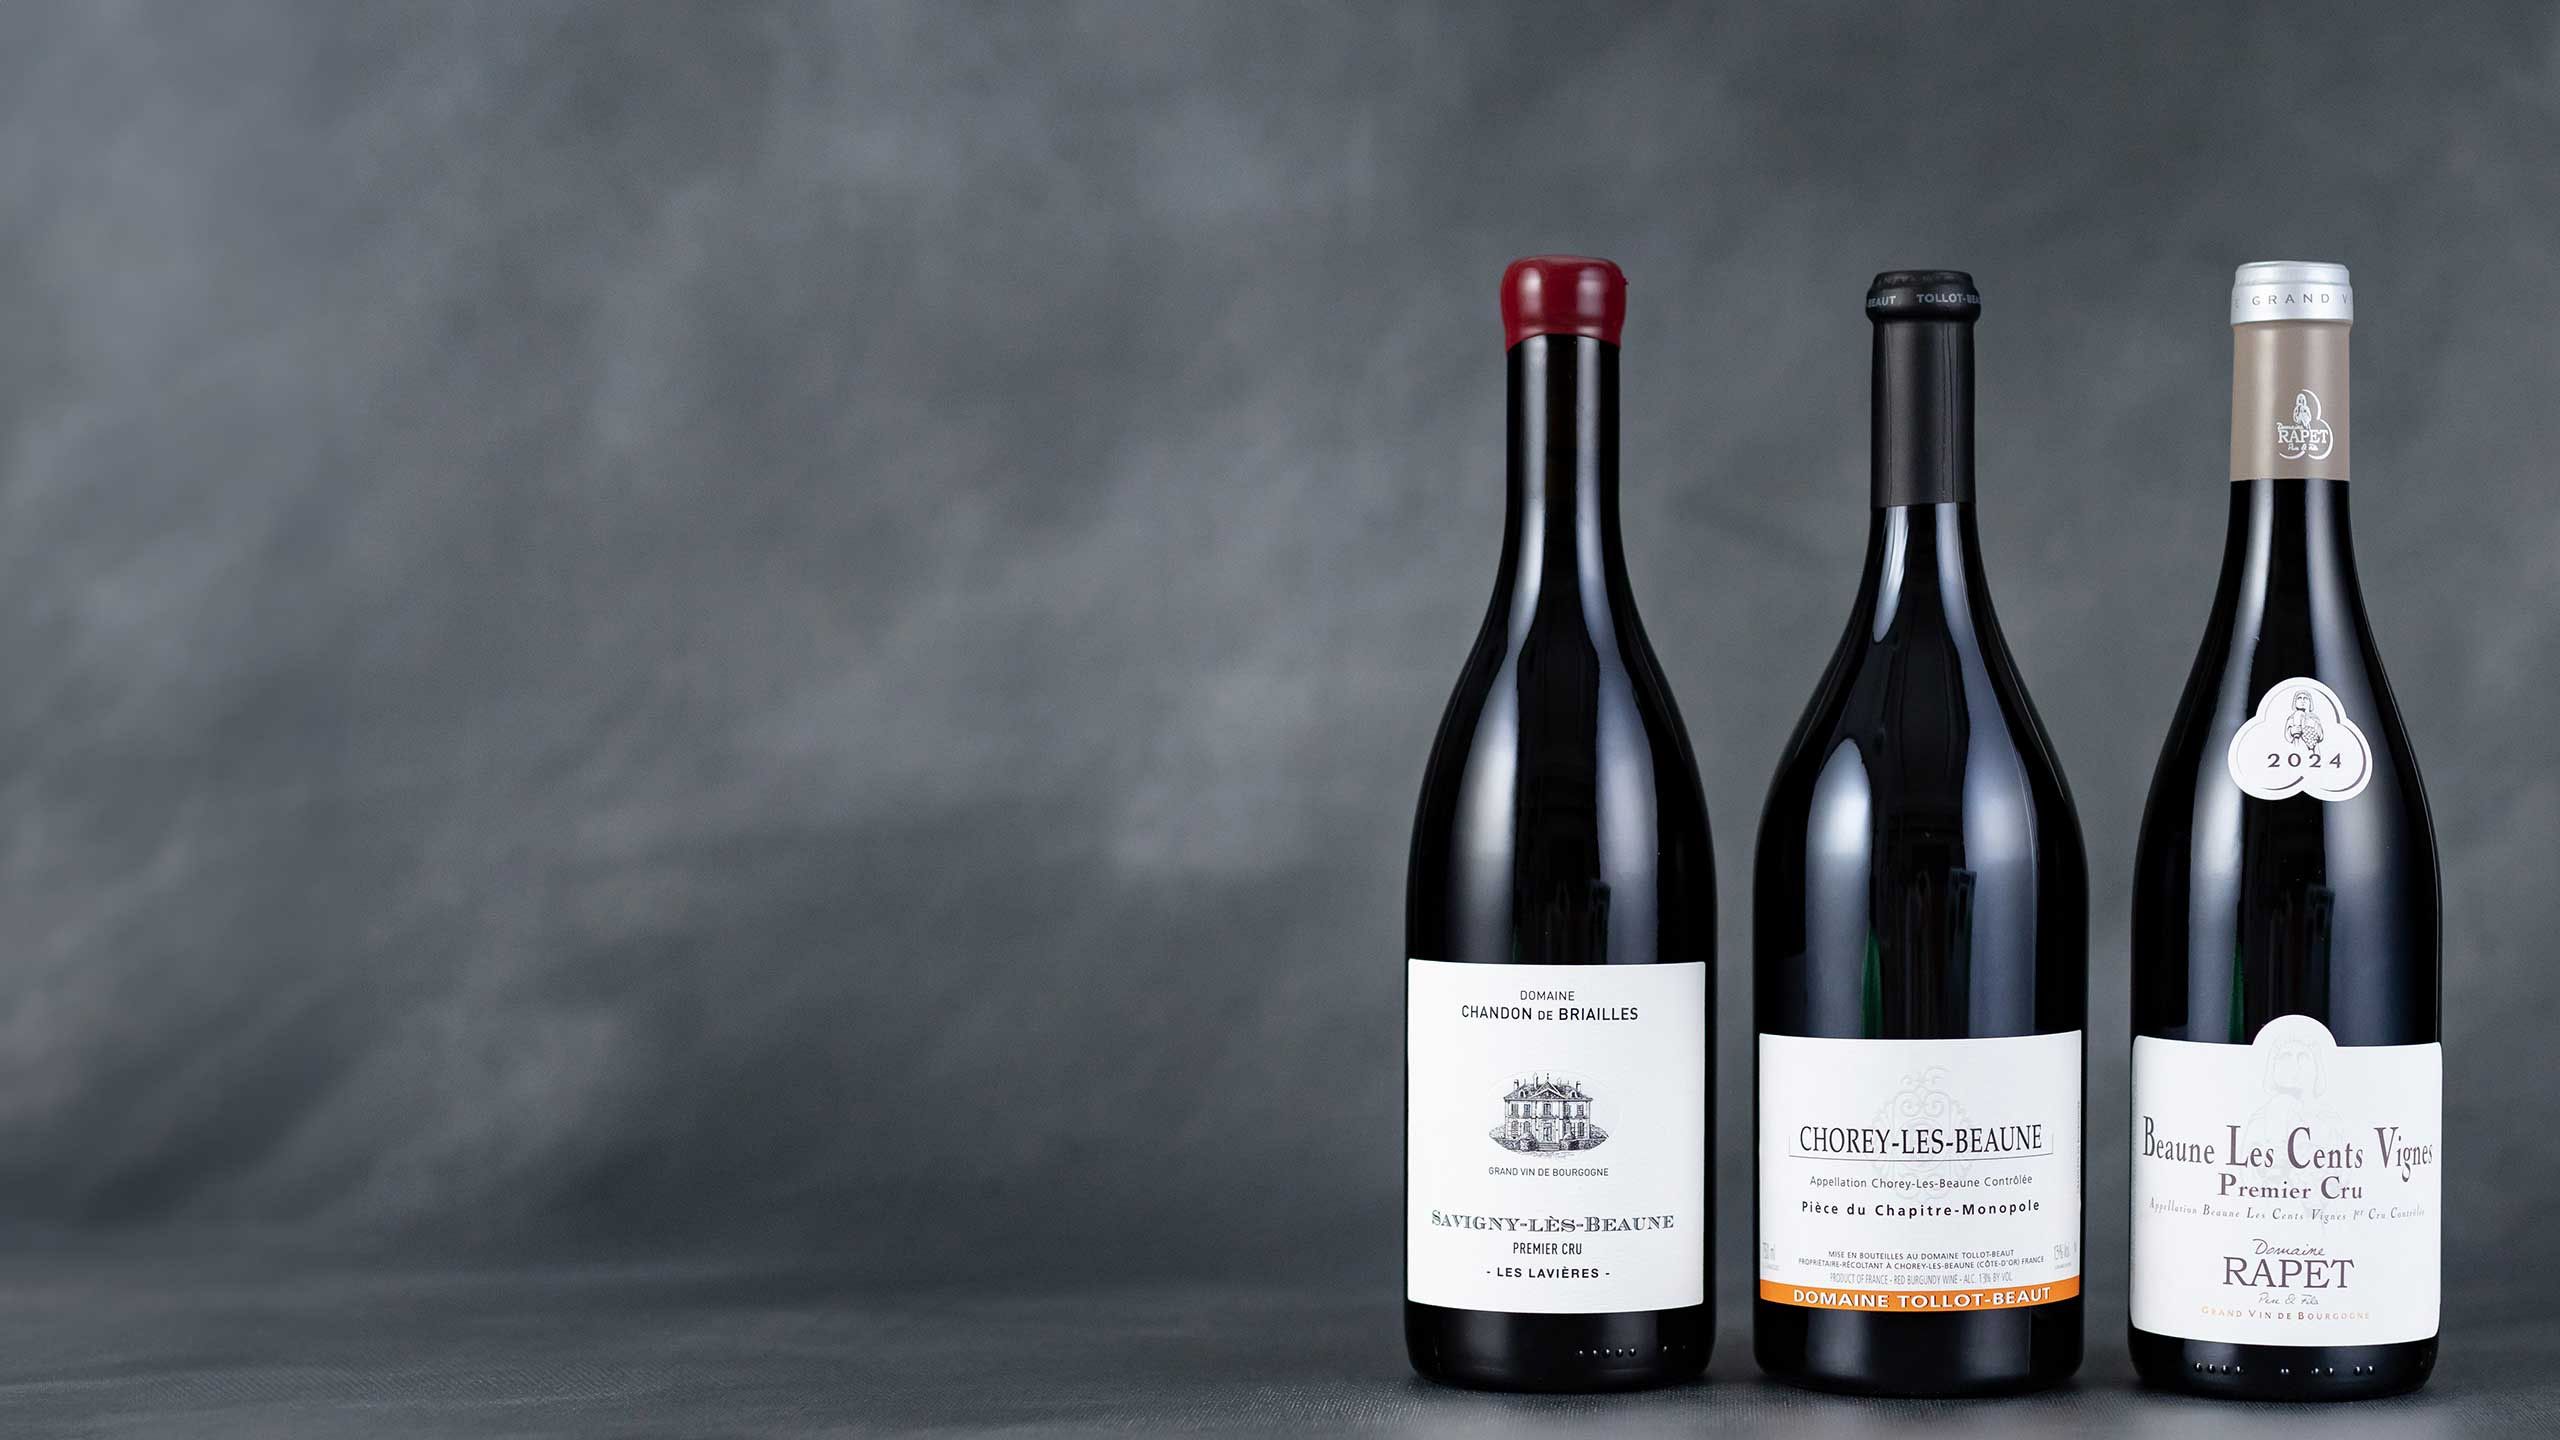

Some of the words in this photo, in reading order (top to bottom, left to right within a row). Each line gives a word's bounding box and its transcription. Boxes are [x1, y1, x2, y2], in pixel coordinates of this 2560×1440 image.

[2251, 293, 2330, 306] GRAND
[2278, 429, 2329, 444] RAPET
[2267, 753, 2342, 769] 2024
[1519, 990, 1576, 1002] DOMAINE
[1461, 1004, 1532, 1021] CHANDON
[1537, 1009, 1554, 1021] DE
[1558, 1007, 1639, 1022] BRIAILLES
[1799, 1123, 2043, 1155] CHOREY-LES-BEAUNE
[2142, 1115, 2216, 1164] Beaune
[2225, 1124, 2274, 1169] Les
[2287, 1126, 2364, 1170] Cents
[2373, 1126, 2433, 1183] Vignes
[1488, 1166, 1519, 1177] GRAND
[1520, 1167, 1536, 1177] VIN
[1537, 1167, 1550, 1177] DE
[1552, 1167, 1609, 1177] BOURGOGNE
[1809, 1175, 1867, 1191] Appellation
[1871, 1177, 1981, 1191] Chorey-Les-Beaune
[1983, 1173, 2033, 1187] Contrôlée
[2216, 1172, 2312, 1200] Premier
[2320, 1175, 2363, 1200] Cru
[1801, 1200, 1839, 1215] Pièce
[1846, 1201, 1866, 1216] du
[1874, 1199, 2040, 1219] Chapitre-Monopole
[2149, 1196, 2198, 1214] Appellation
[2202, 1203, 2240, 1218] Beaune
[2246, 1206, 2266, 1219] Les
[2272, 1207, 2304, 1220] Cents
[2312, 1208, 2346, 1225] Vignes
[2368, 1207, 2386, 1220] Cru
[1512, 1242, 1559, 1255] PREMIER
[1561, 1243, 1582, 1256] CRU
[1828, 1250, 1845, 1258] MISE
[1847, 1251, 1857, 1259] EN
[1859, 1251, 1904, 1260] BOUTEILLES
[1920, 1252, 1959, 1260] DOMAINE
[1961, 1249, 2015, 1260] TOLLOT-BEAUT
[2252, 1238, 2326, 1257] Domaine
[1894, 1261, 1975, 1270] CHOREY-LES-BEAUNE
[2021, 1255, 2045, 1265] FRANCE
[1496, 1267, 1522, 1278] LES
[1528, 1265, 1600, 1279] LAVIÈRES
[1830, 1272, 1855, 1284] PRODUCT
[1856, 1273, 1865, 1284] OF
[1865, 1274, 1888, 1285] FRANCE
[1894, 1274, 1906, 1285] RED
[1907, 1274, 1941, 1286] BURGUNDY
[1942, 1274, 1958, 1285] WINE
[2222, 1256, 2355, 1289] RAPET
[1793, 1288, 1890, 1308] DOMAINE
[1896, 1286, 2052, 1308] TOLLOT-BEAUT
[2201, 1305, 2243, 1318] GRAND
[2248, 1309, 2272, 1320] VIN
[2277, 1312, 2292, 1320] DE
[2297, 1311, 2370, 1321] BOURGOGNE
